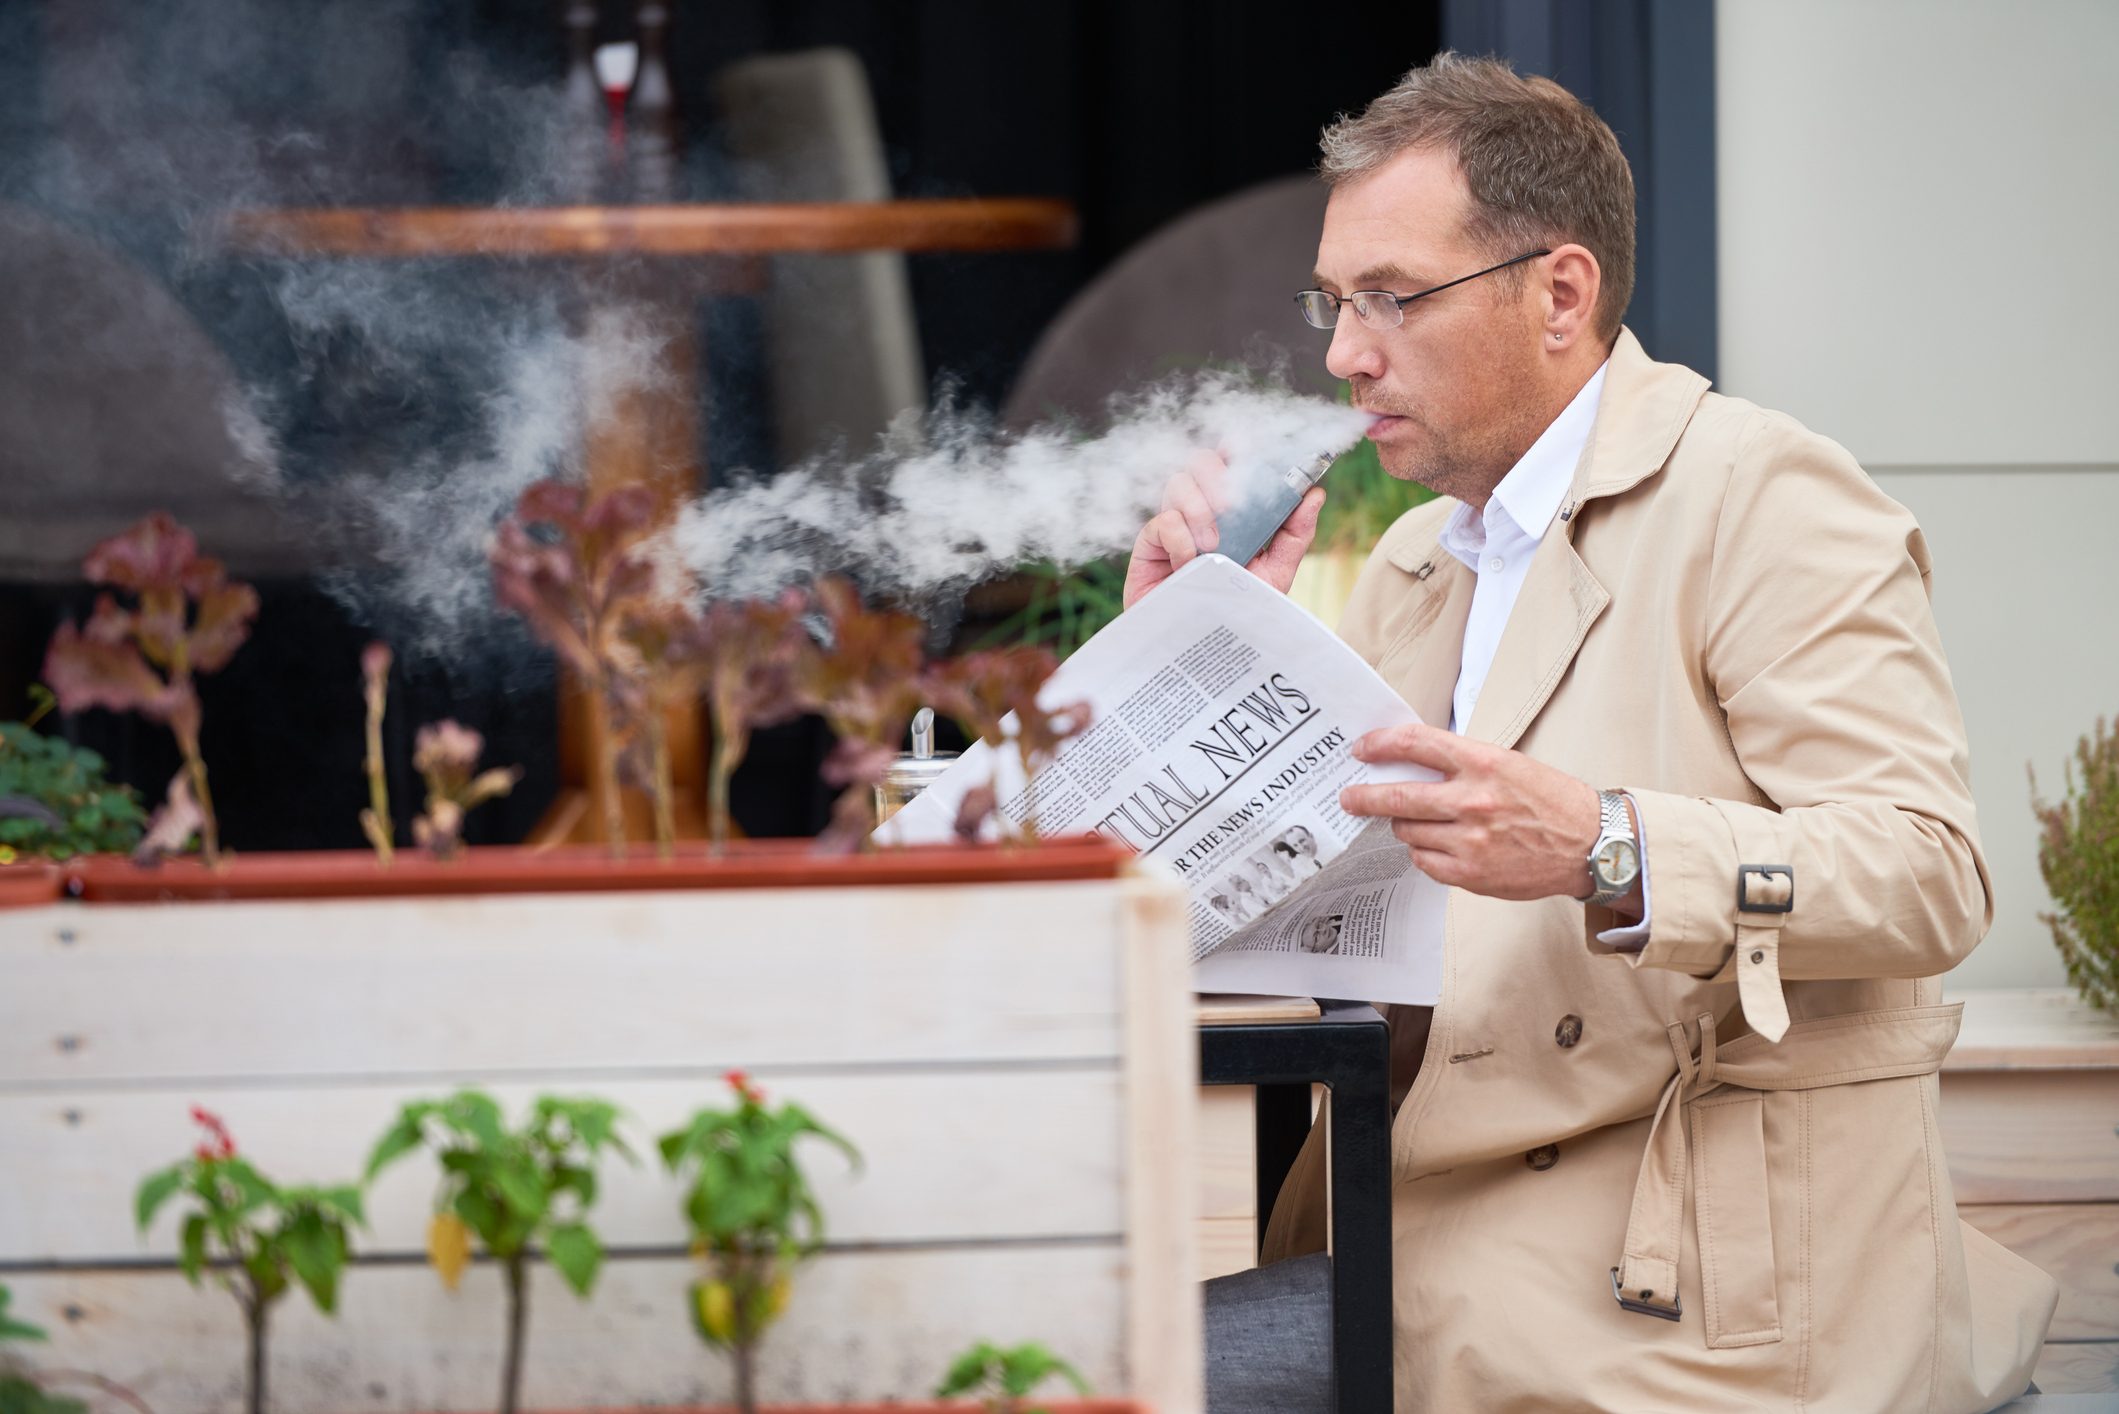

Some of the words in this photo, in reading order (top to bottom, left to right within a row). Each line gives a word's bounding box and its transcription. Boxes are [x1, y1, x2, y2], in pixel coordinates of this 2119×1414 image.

[1086, 764, 1210, 852] TUAL
[1190, 672, 1312, 780] NEWS
[1185, 829, 1224, 861] THE
[1217, 796, 1265, 837] NEWS
[1261, 726, 1347, 802] INDUSTRY
[1363, 907, 1371, 926] makes
[1368, 907, 1378, 933] correctly
[1376, 906, 1384, 920] help.
[1343, 930, 1348, 939] we
[1348, 927, 1356, 944] point
[1359, 927, 1369, 956] beginning
